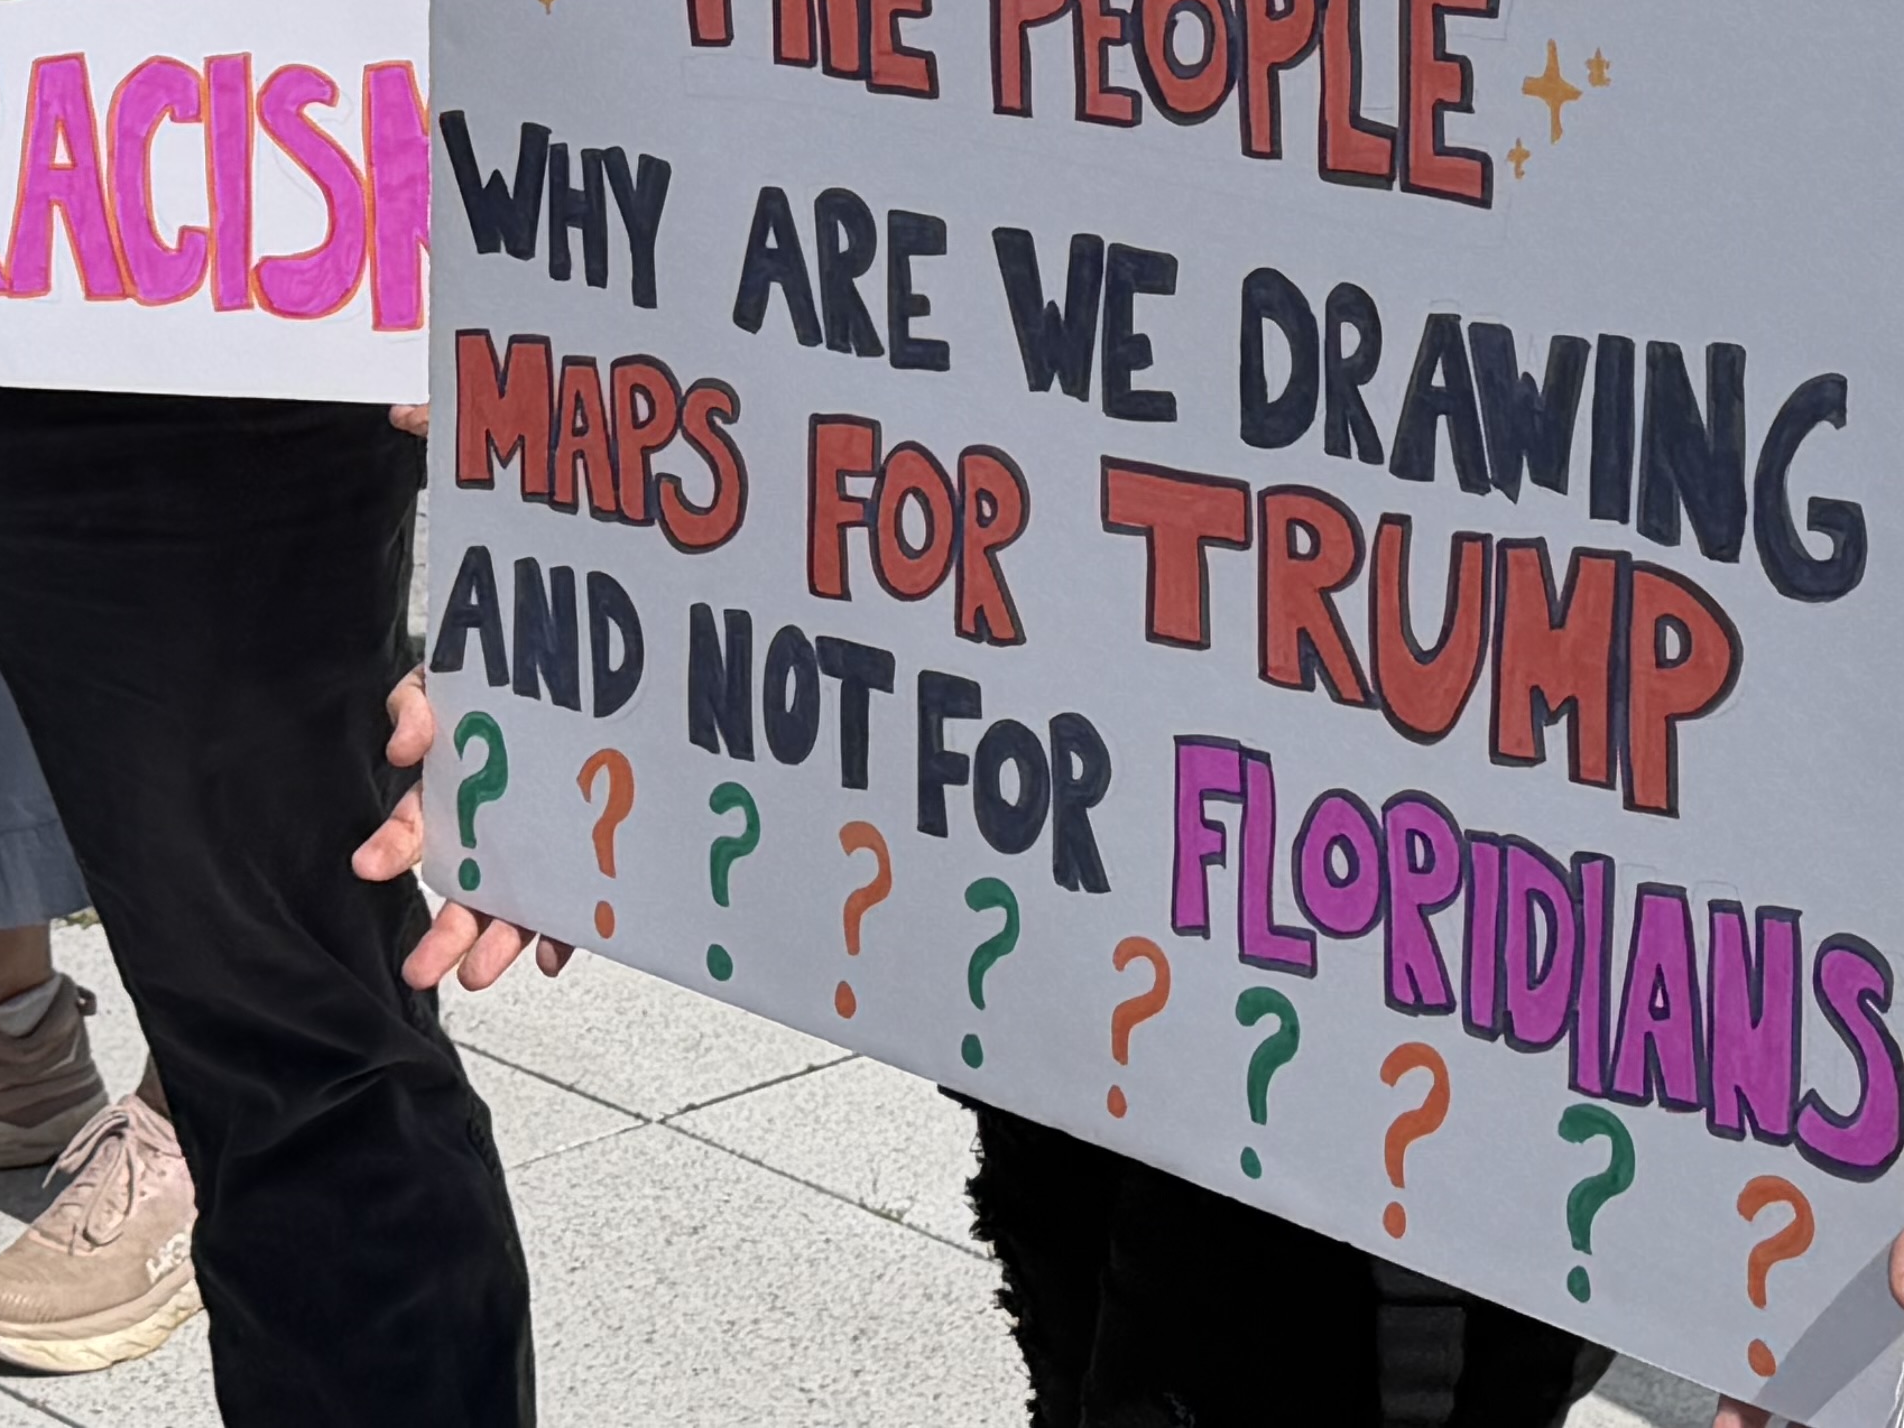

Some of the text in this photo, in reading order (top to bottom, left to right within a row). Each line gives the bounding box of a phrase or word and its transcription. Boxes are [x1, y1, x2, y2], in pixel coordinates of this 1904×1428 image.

[439, 111, 1870, 603] WHY ARE WE DRAWING
[455, 329, 1742, 818] MAPS FOR TRUMP
[429, 546, 644, 719] AND
[687, 602, 895, 790] NOT
[917, 670, 1113, 896] FOR
